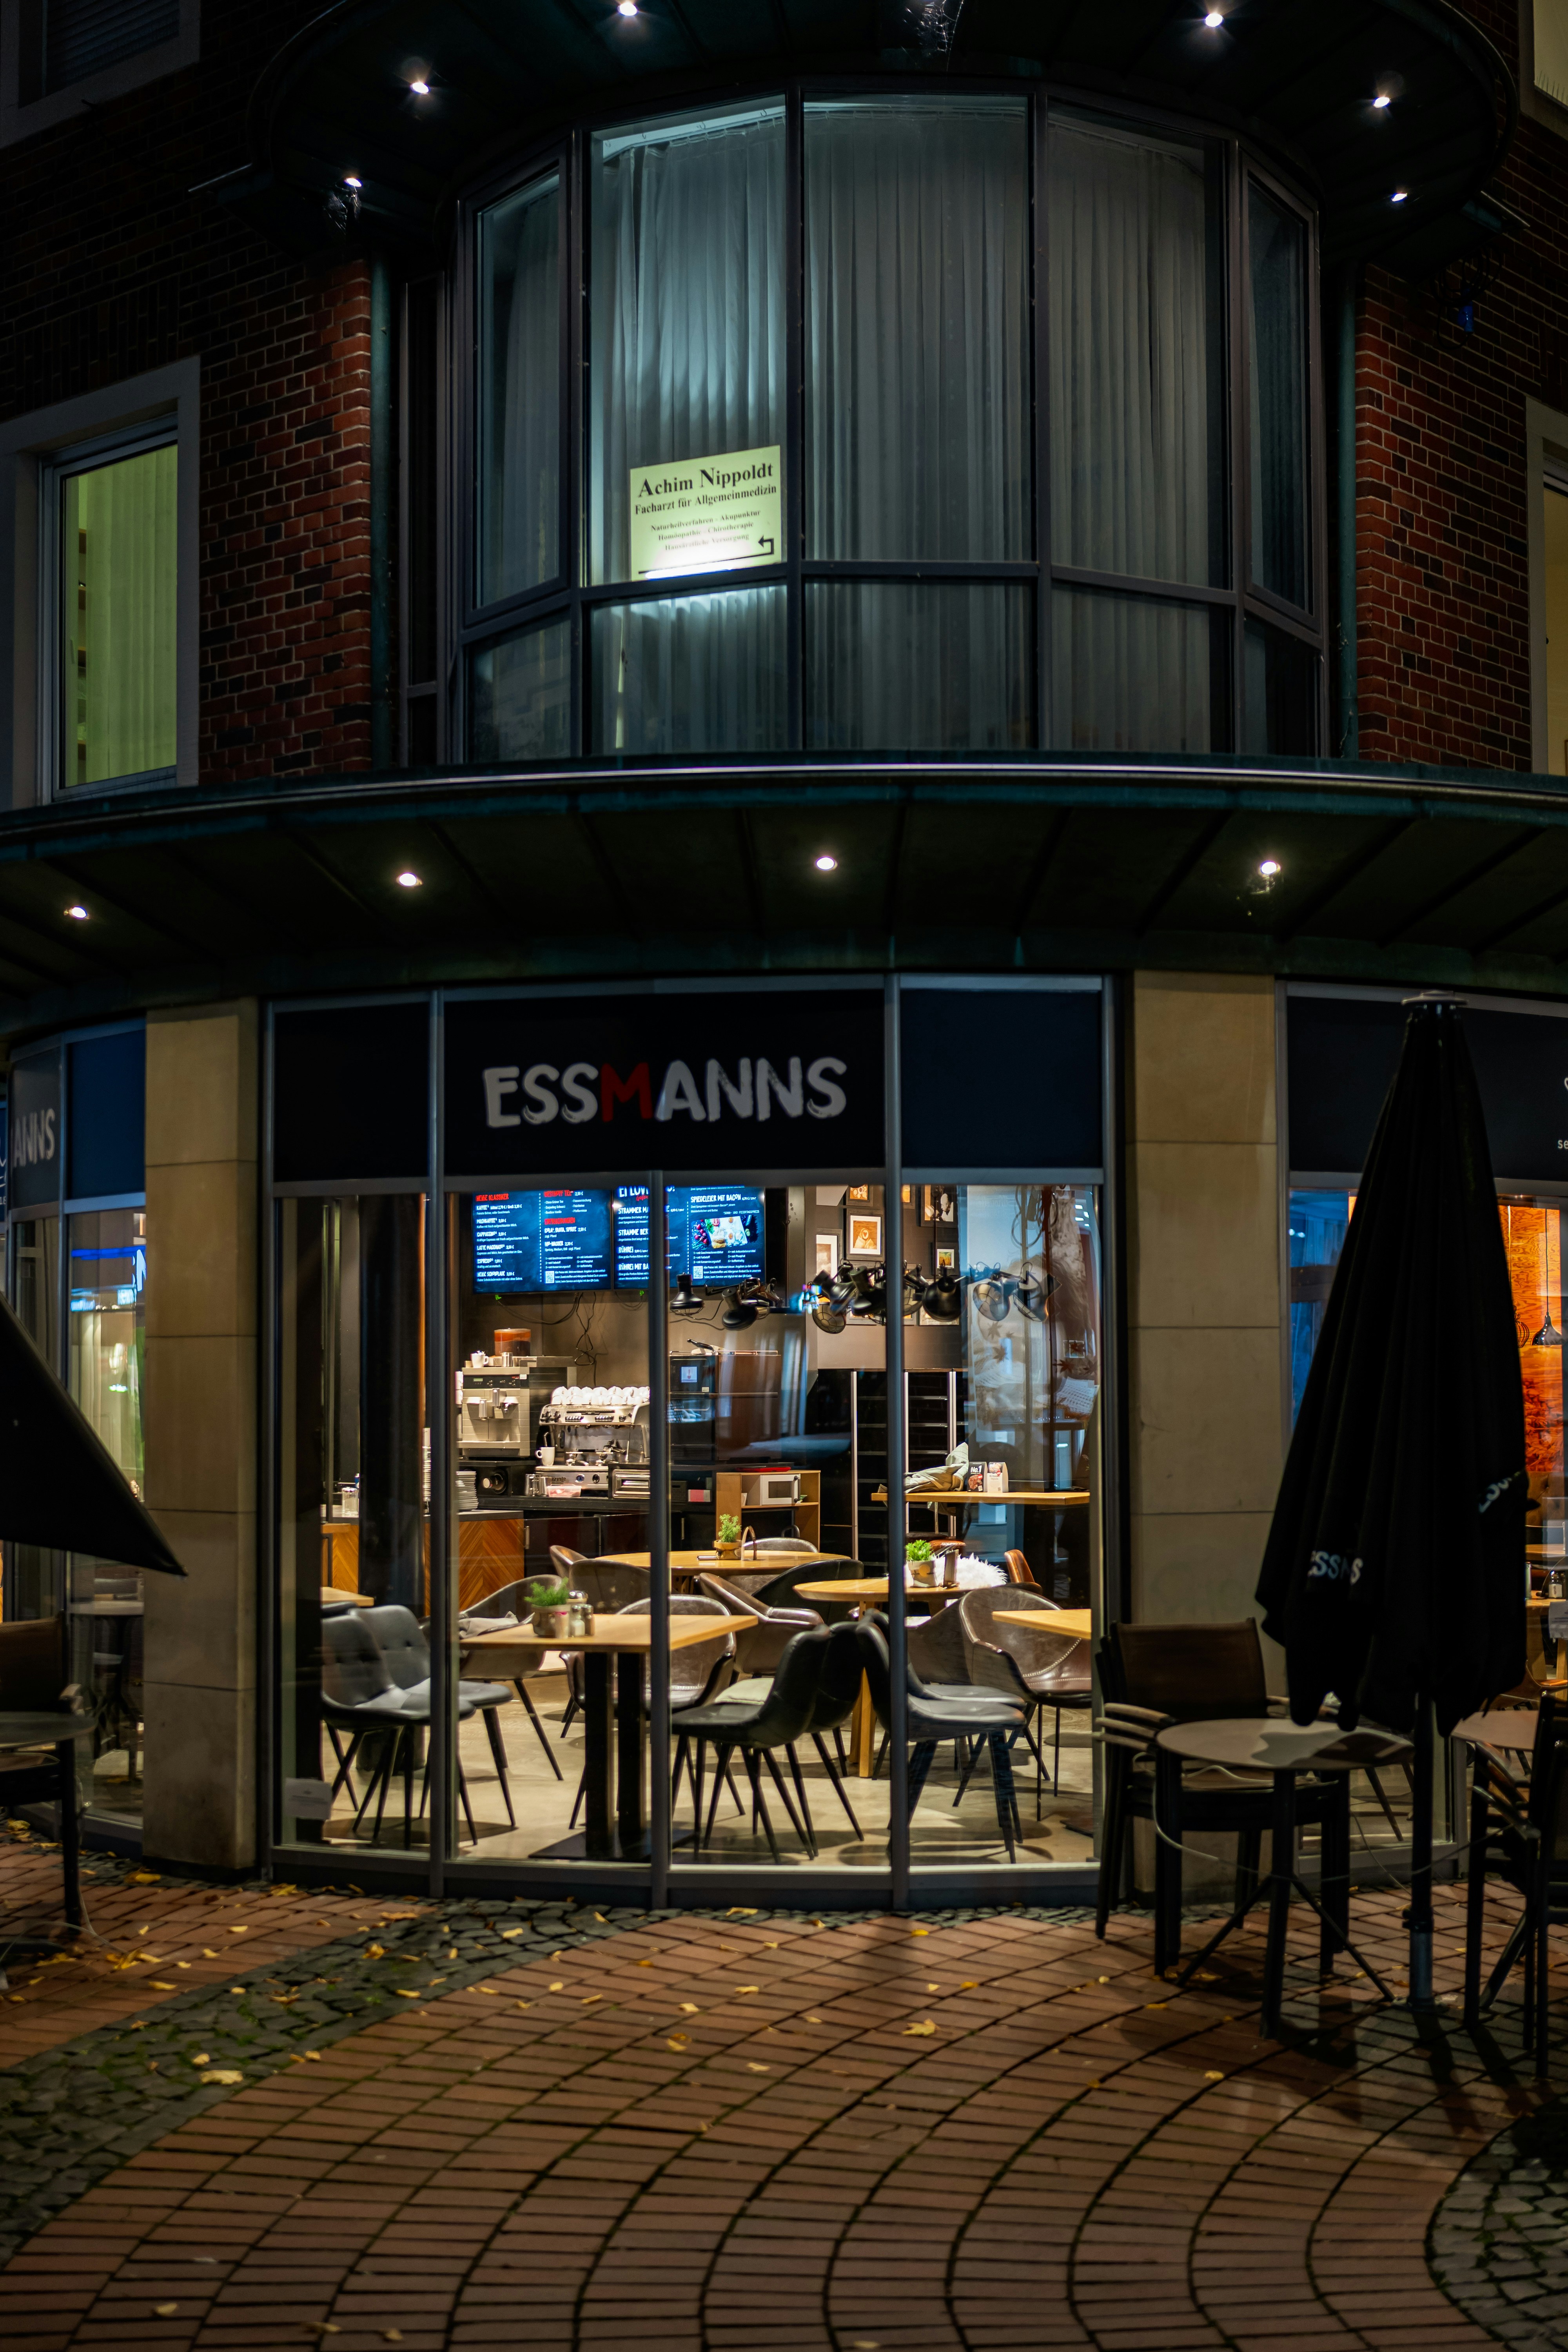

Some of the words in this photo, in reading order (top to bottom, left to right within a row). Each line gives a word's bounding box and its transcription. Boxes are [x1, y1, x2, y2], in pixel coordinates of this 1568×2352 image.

[638, 477, 693, 497] Achim
[699, 463, 774, 488] Nippoldt
[635, 501, 675, 515] Facharzt
[678, 497, 691, 508] für
[695, 484, 777, 506] Allgemeinmedizin
[651, 517, 713, 532] Naturheilverfahren
[720, 510, 760, 521] Akupunktur
[659, 530, 701, 541] Homöopathie
[708, 521, 754, 533] Chirotherapie
[665, 540, 709, 550] Hausärztliche
[712, 534, 749, 544] Versorgung
[483, 1056, 848, 1128] ESSMANNS
[619, 1206, 642, 1214] STRAMMER
